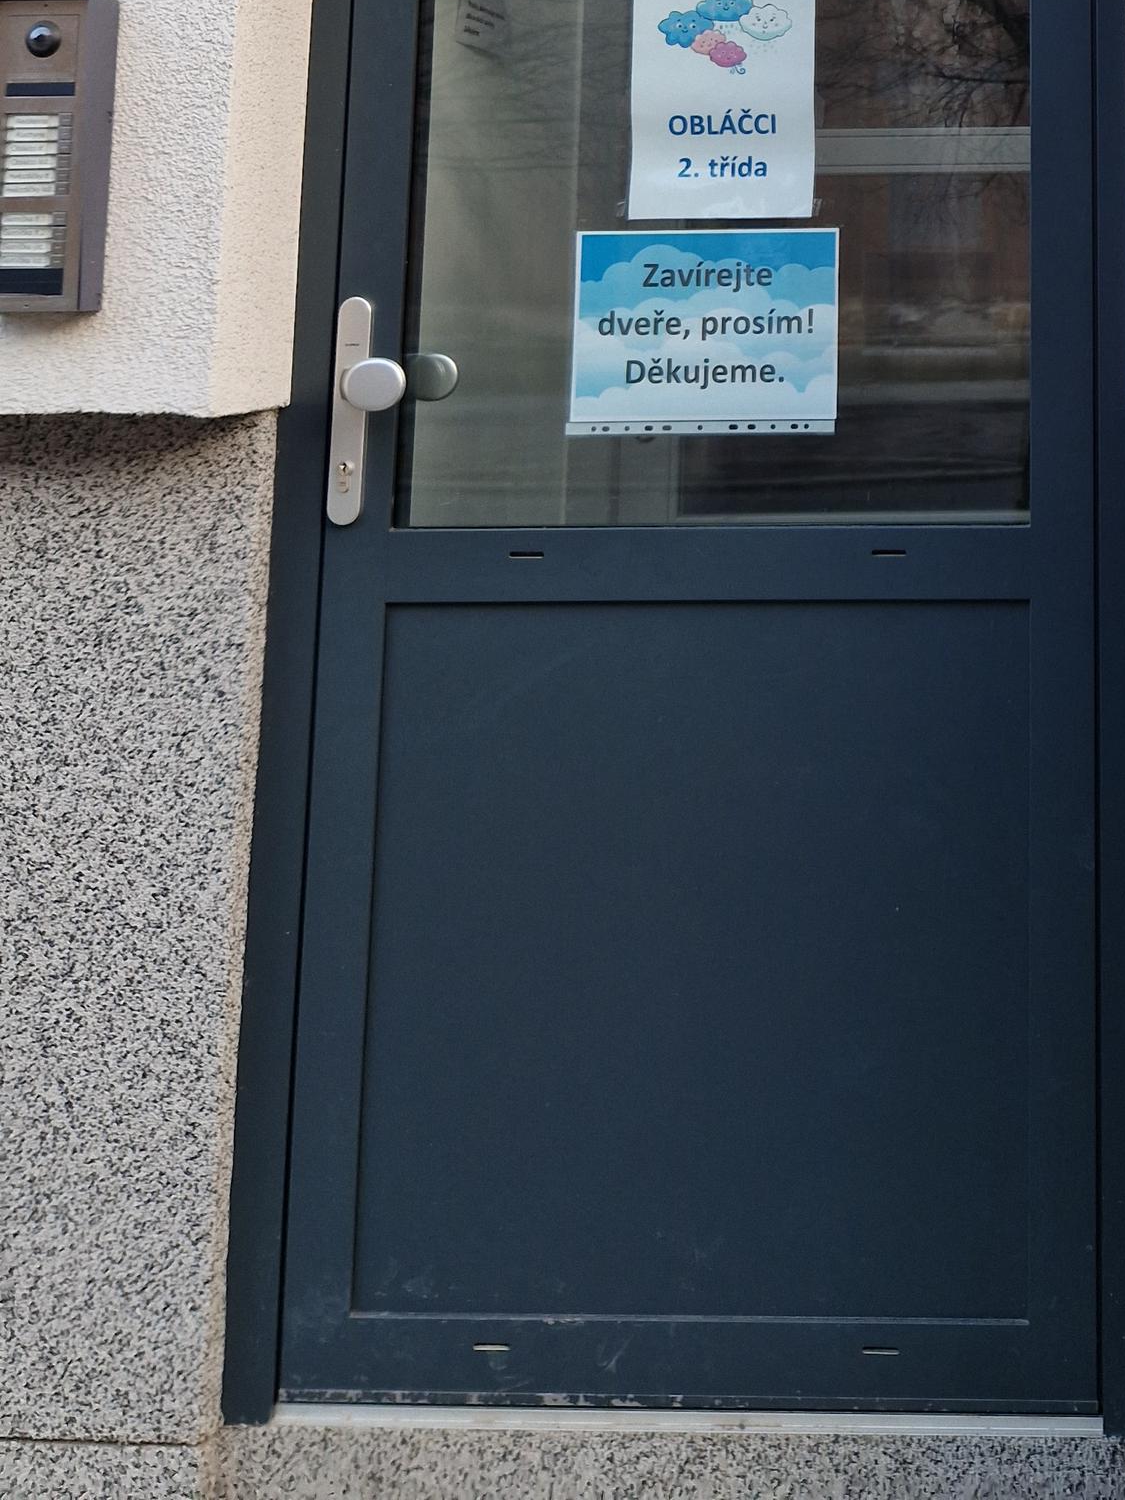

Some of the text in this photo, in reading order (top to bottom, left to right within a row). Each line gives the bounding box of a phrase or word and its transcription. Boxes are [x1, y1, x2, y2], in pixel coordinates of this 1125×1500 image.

[668, 108, 777, 136] OBLÁČCI
[678, 155, 768, 178] 2. třída
[643, 262, 773, 293] Zavírejte
[598, 308, 814, 341] dveře, prosím!
[625, 357, 785, 390] Děkujeme.
